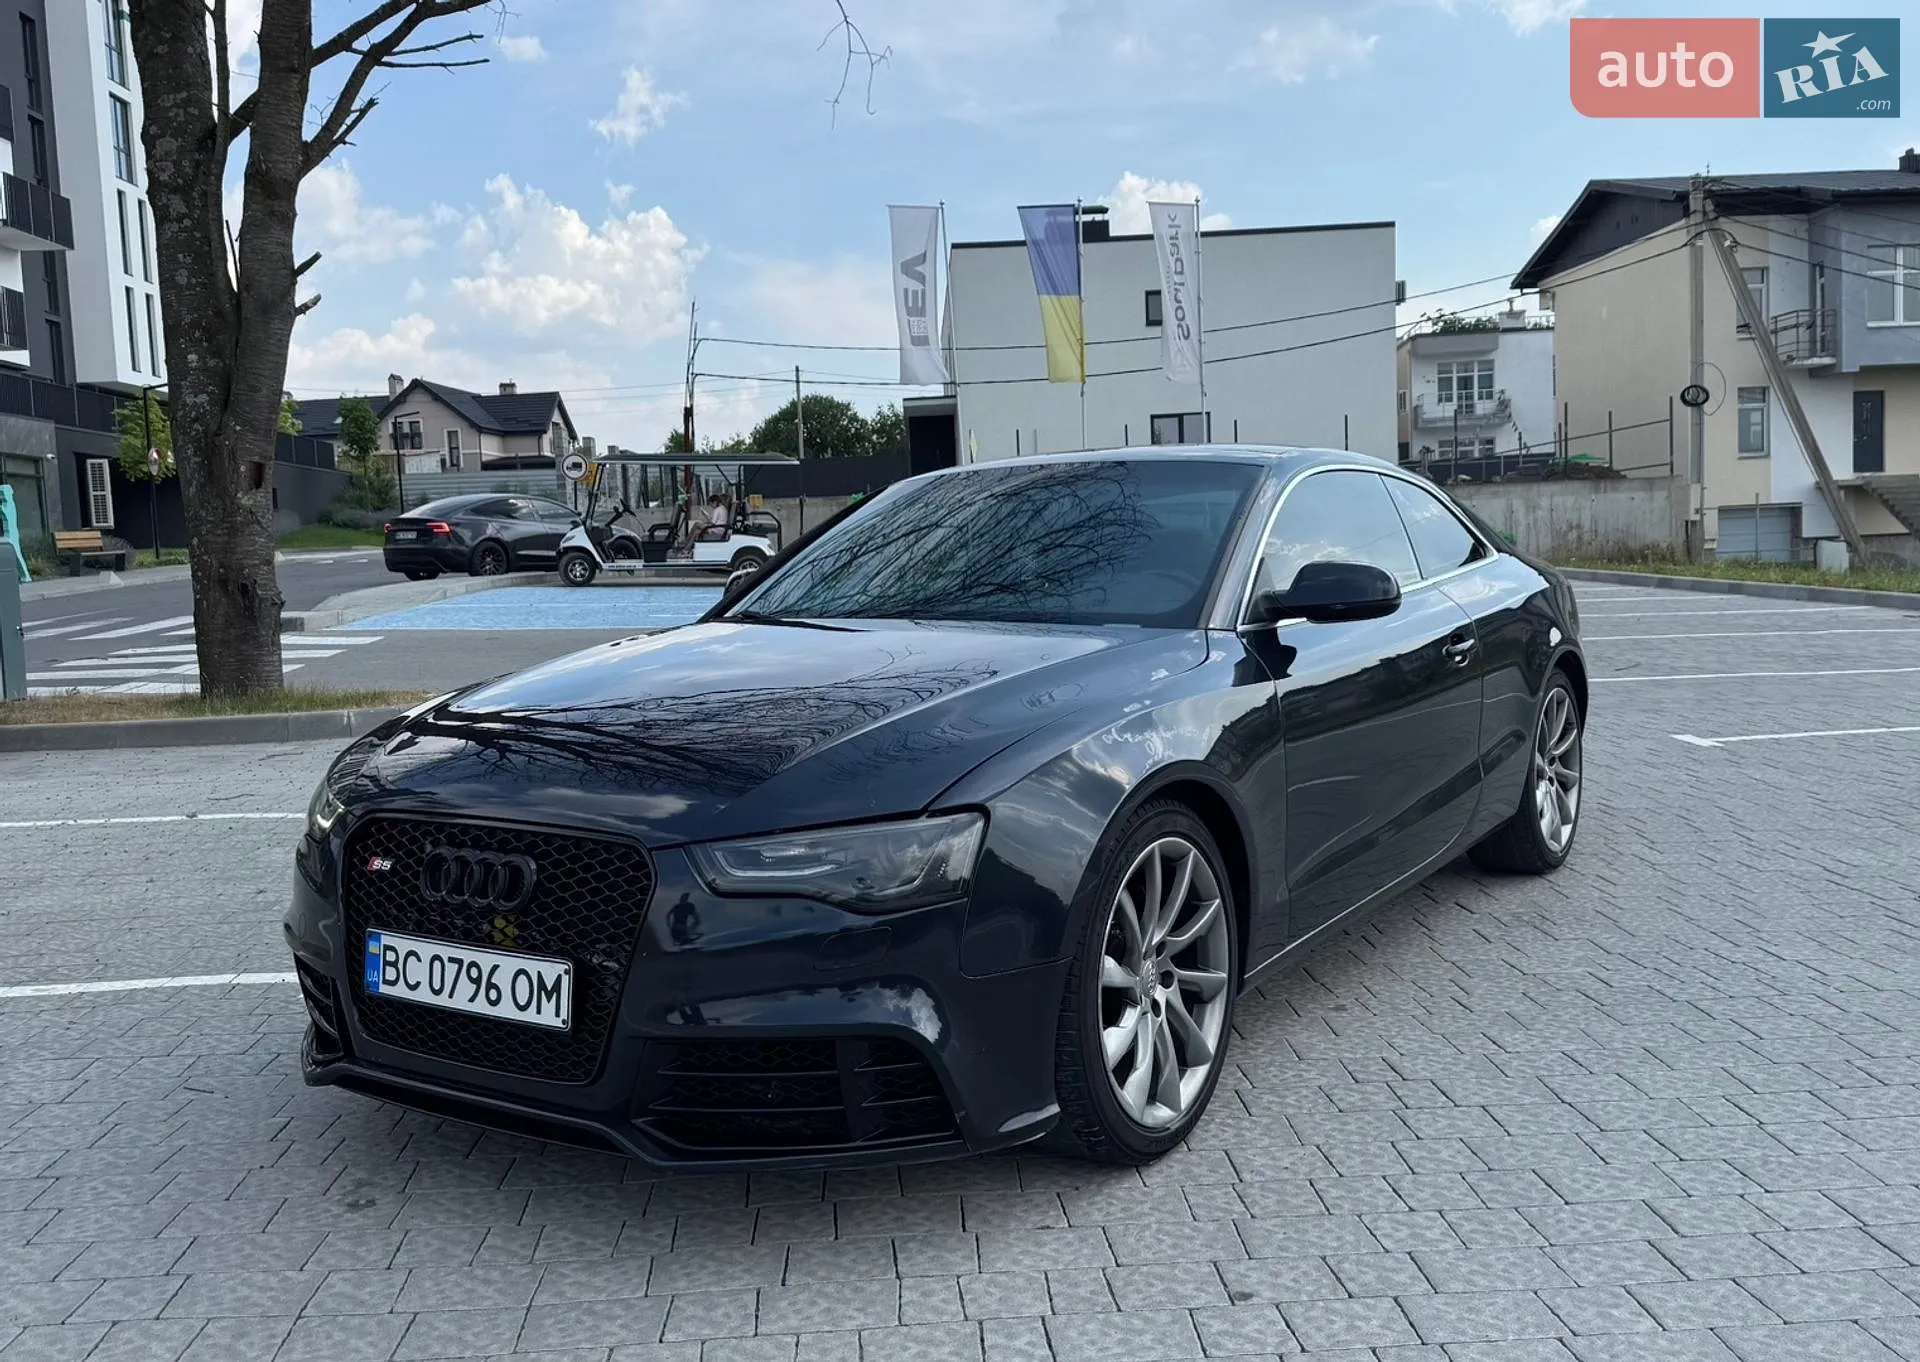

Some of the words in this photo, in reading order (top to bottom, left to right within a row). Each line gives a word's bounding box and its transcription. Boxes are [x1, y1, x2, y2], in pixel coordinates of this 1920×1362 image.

[372, 859, 393, 871] S5
[367, 969, 379, 983] UA
[382, 943, 422, 991] BC
[428, 954, 503, 1007] 0796
[510, 968, 562, 1018] OM
